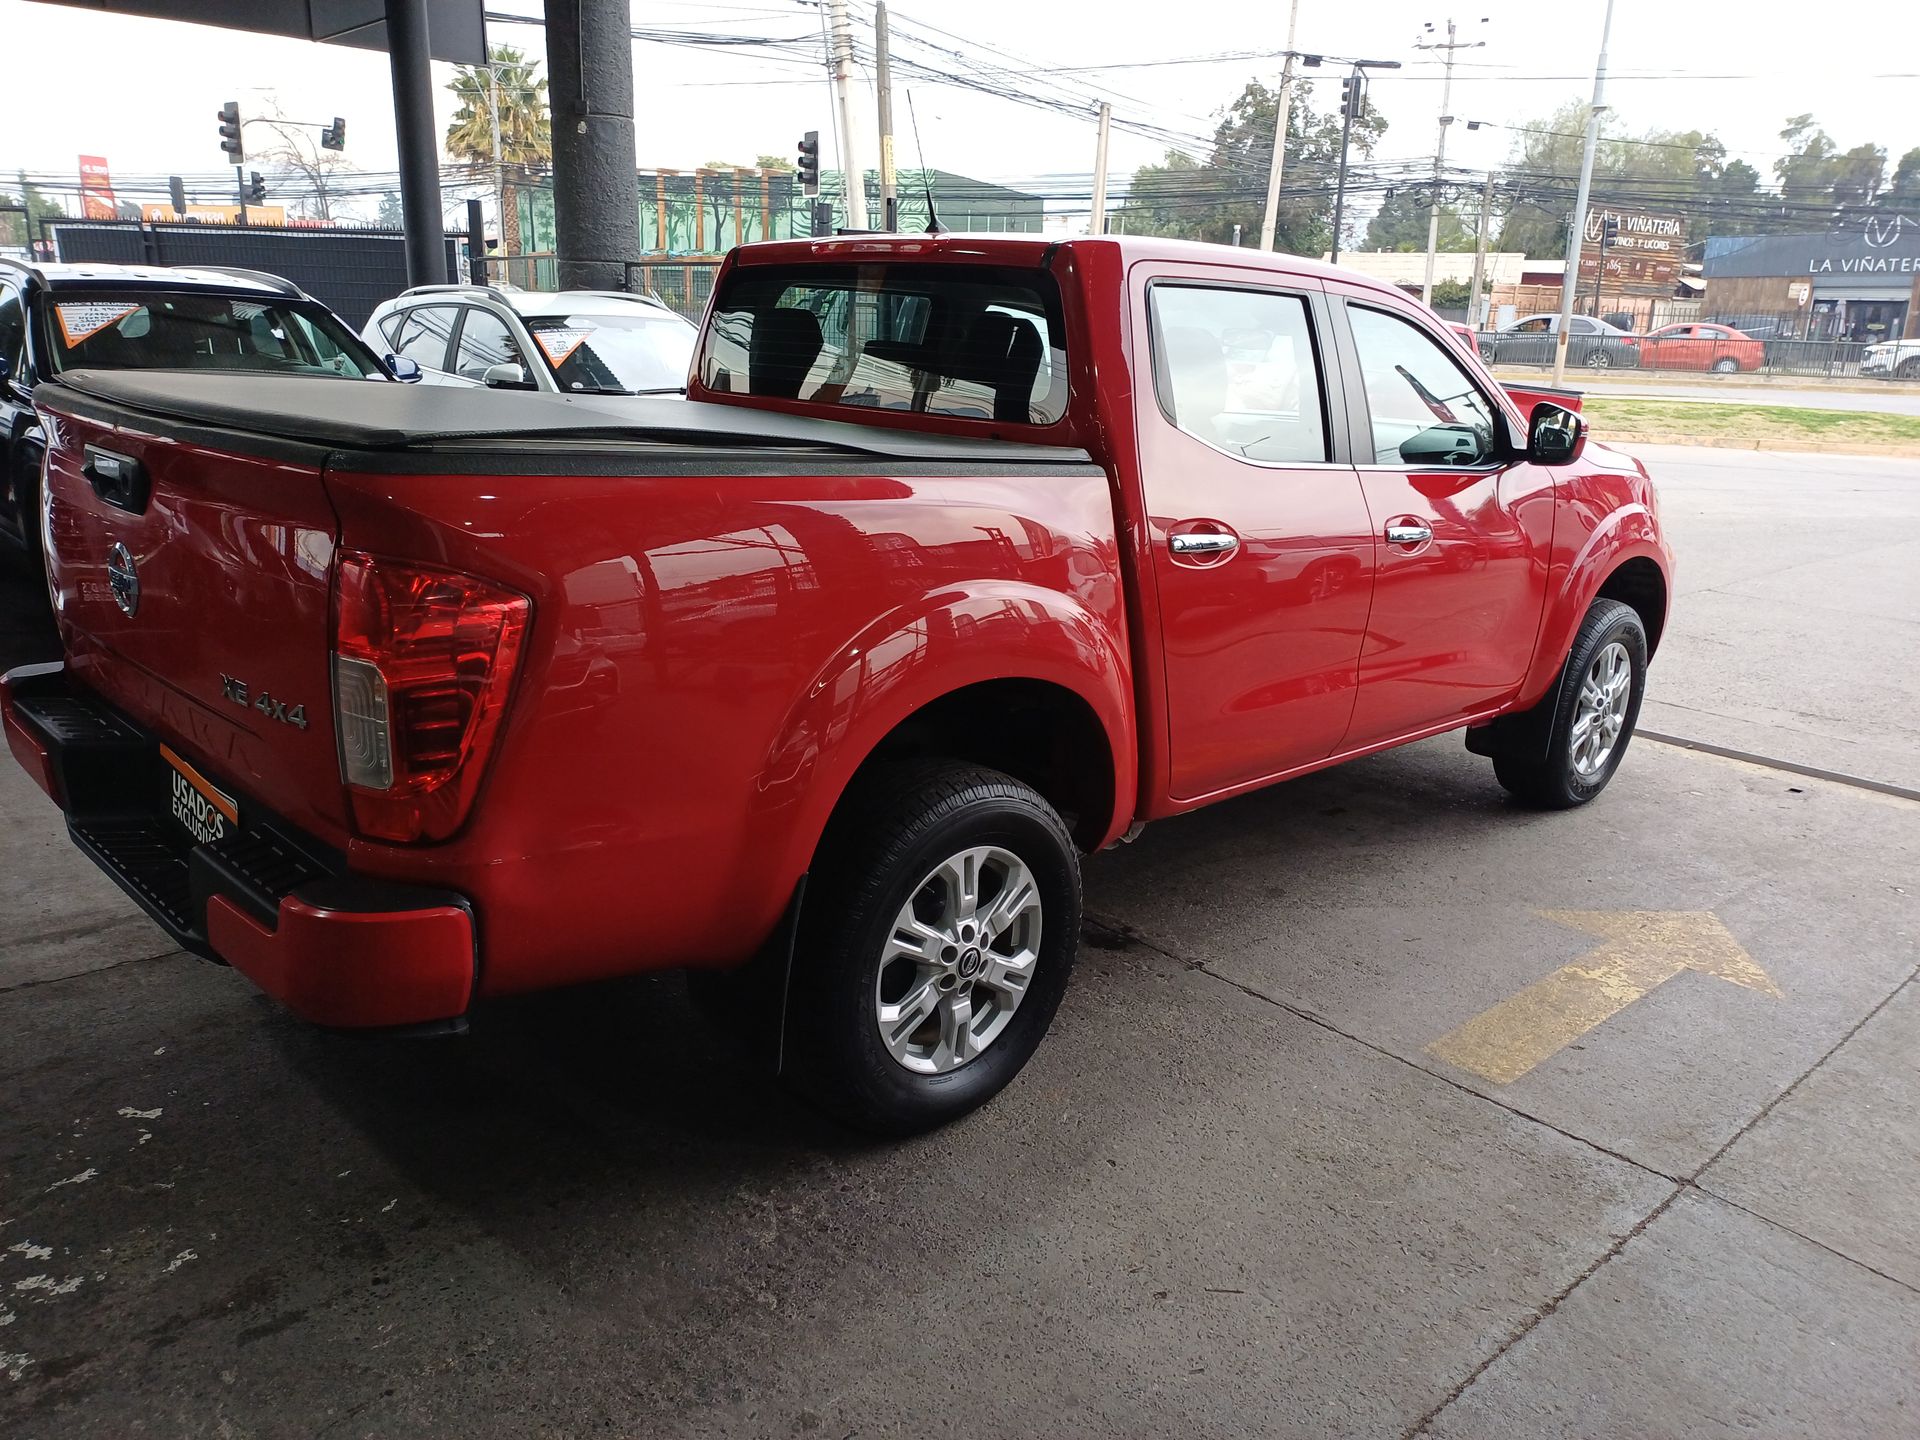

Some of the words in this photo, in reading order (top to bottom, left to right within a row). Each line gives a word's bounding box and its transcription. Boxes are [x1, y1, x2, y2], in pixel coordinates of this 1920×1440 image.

[1627, 215, 1681, 236] VIÑATERÍA
[1614, 235, 1635, 248] VINOS
[1637, 238, 1643, 248] Y
[1644, 239, 1671, 251] LICORES
[1809, 258, 1832, 273] LA
[220, 672, 248, 708] XE
[172, 769, 224, 840] USADOS
[172, 795, 217, 844] EXCLUSIV
